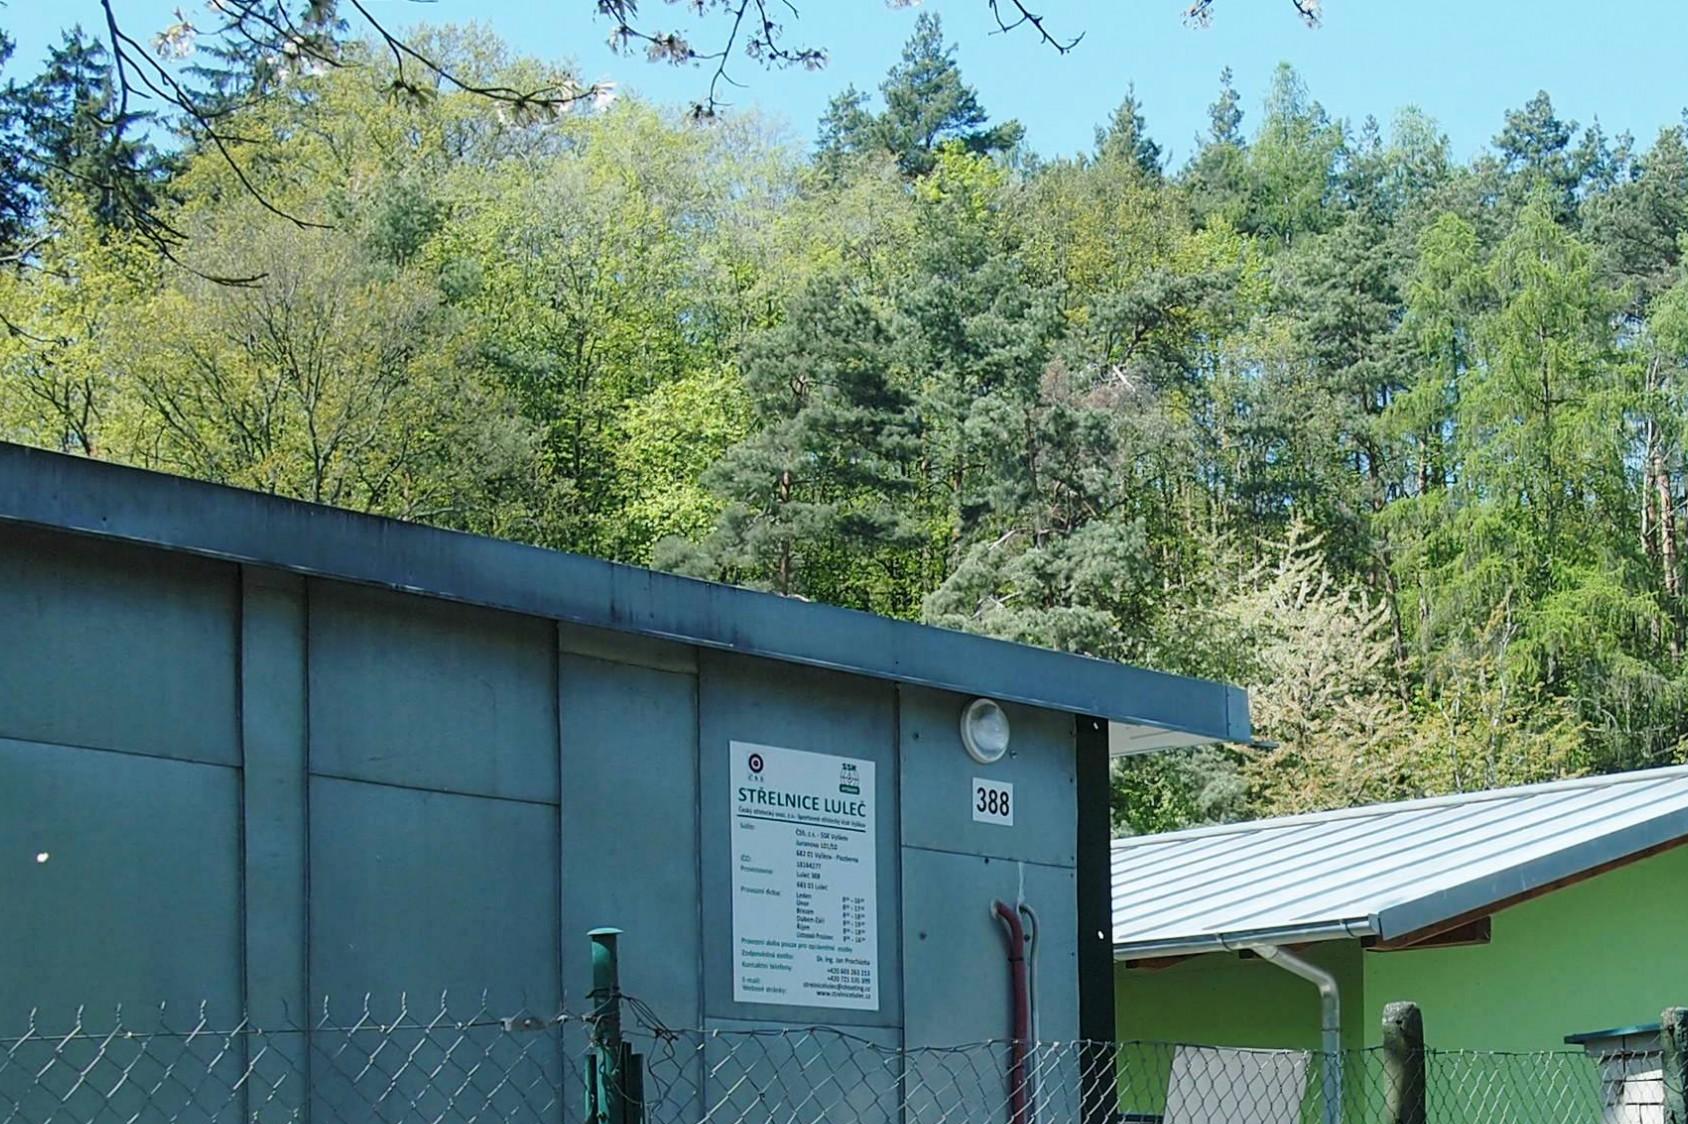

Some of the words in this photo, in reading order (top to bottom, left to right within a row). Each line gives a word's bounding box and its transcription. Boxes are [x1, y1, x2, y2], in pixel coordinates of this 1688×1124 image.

[738, 786, 820, 811] STŘELNICE
[824, 799, 866, 818] LULEČ
[977, 787, 1009, 816] 388
